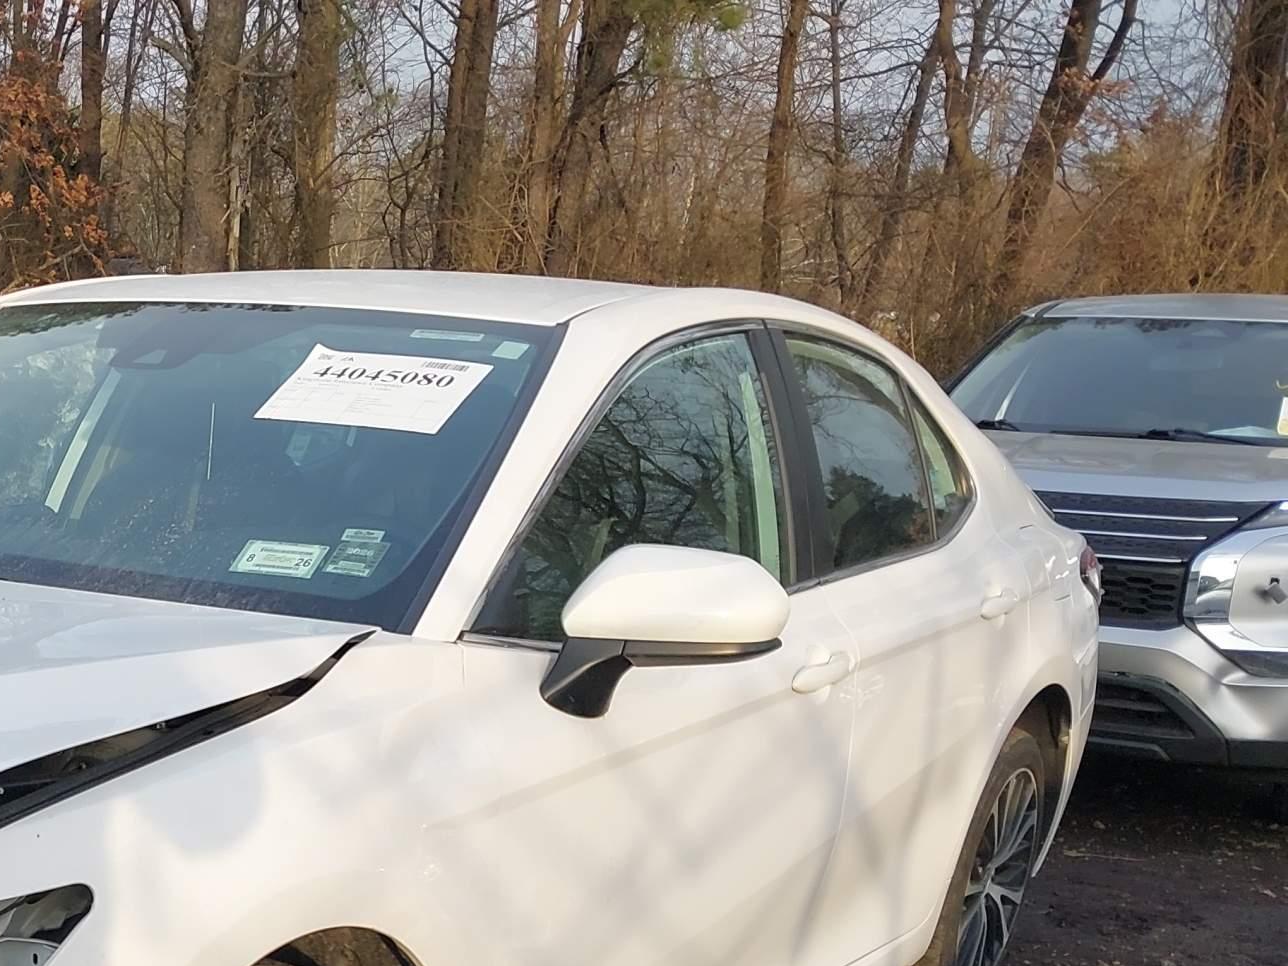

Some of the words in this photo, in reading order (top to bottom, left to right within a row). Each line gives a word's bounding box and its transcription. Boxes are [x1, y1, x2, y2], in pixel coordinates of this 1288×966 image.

[313, 365, 455, 388] 44045080
[246, 553, 256, 563] 8
[294, 558, 312, 567] 26
